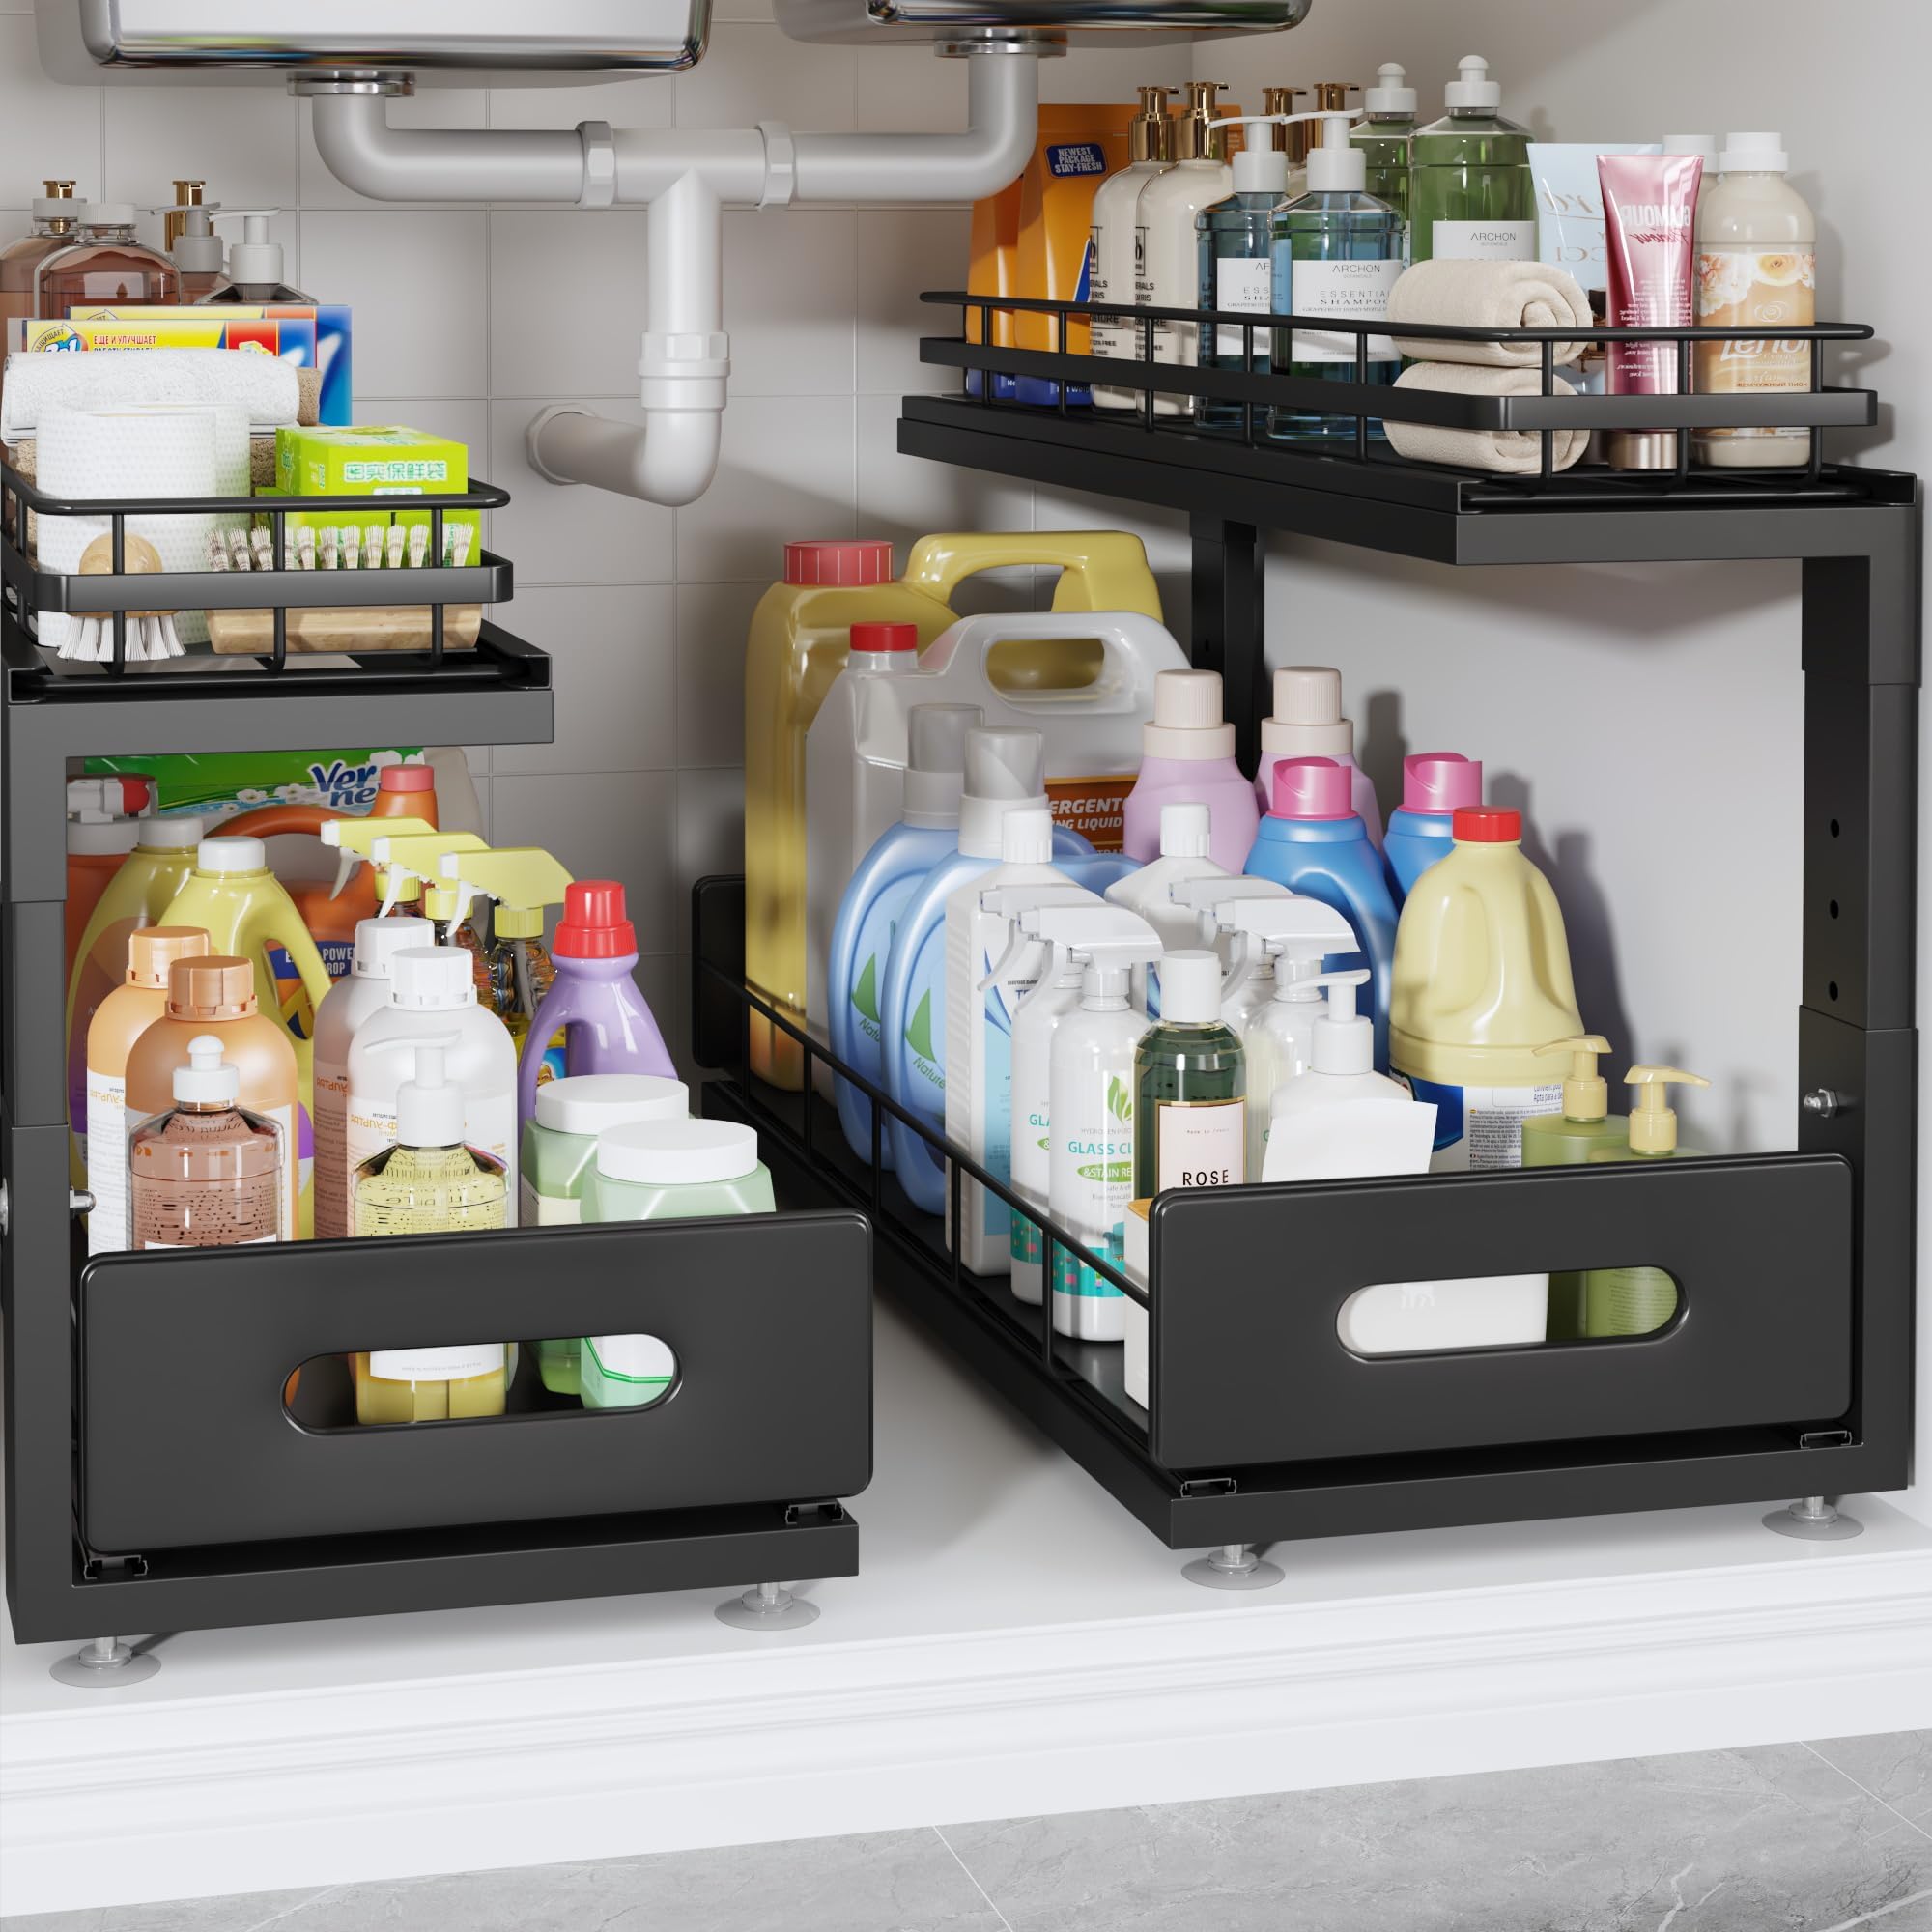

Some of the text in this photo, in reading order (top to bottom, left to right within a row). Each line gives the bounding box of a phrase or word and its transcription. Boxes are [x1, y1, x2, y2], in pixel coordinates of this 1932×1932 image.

[1058, 147, 1091, 156] NEWEST
[1059, 155, 1095, 164] PACKAGE
[1054, 161, 1102, 173] STAY-FRESH
[1470, 232, 1517, 242] ARCHON
[1332, 264, 1381, 273] ARCHON
[94, 335, 156, 345] ЕЩЕ И УЛУЧШАЕТ
[311, 762, 377, 792] Ver
[330, 784, 381, 807] ne
[1077, 817, 1122, 830] LIQUID
[1068, 1141, 1115, 1155] GLASS
[1182, 1170, 1229, 1186] ROSE
